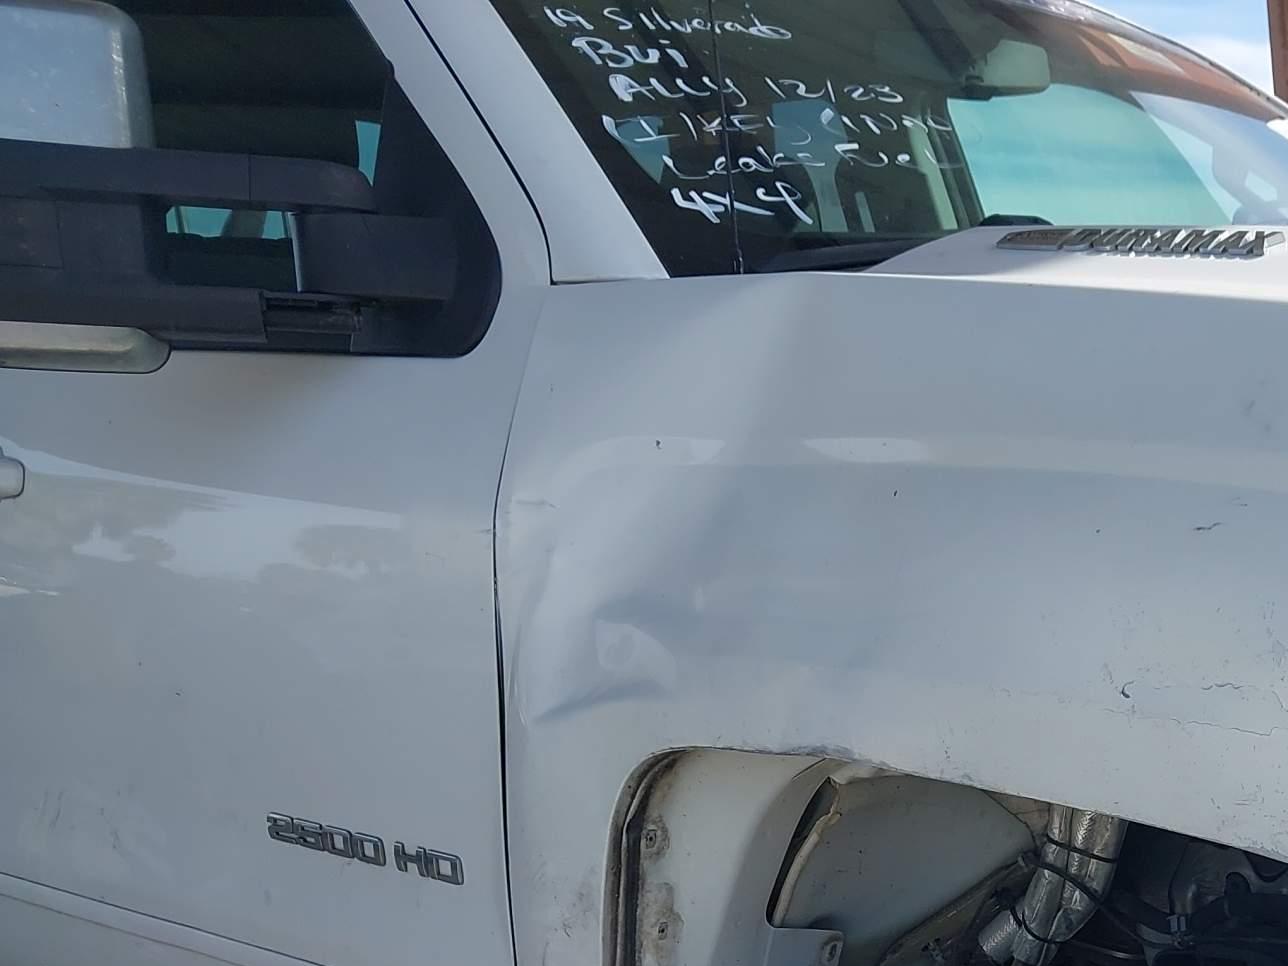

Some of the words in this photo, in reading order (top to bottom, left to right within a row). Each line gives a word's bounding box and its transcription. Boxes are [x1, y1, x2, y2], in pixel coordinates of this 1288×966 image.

[1057, 227, 1268, 258] DURAMAX
[266, 811, 387, 867] 2500
[393, 840, 465, 886] HD
